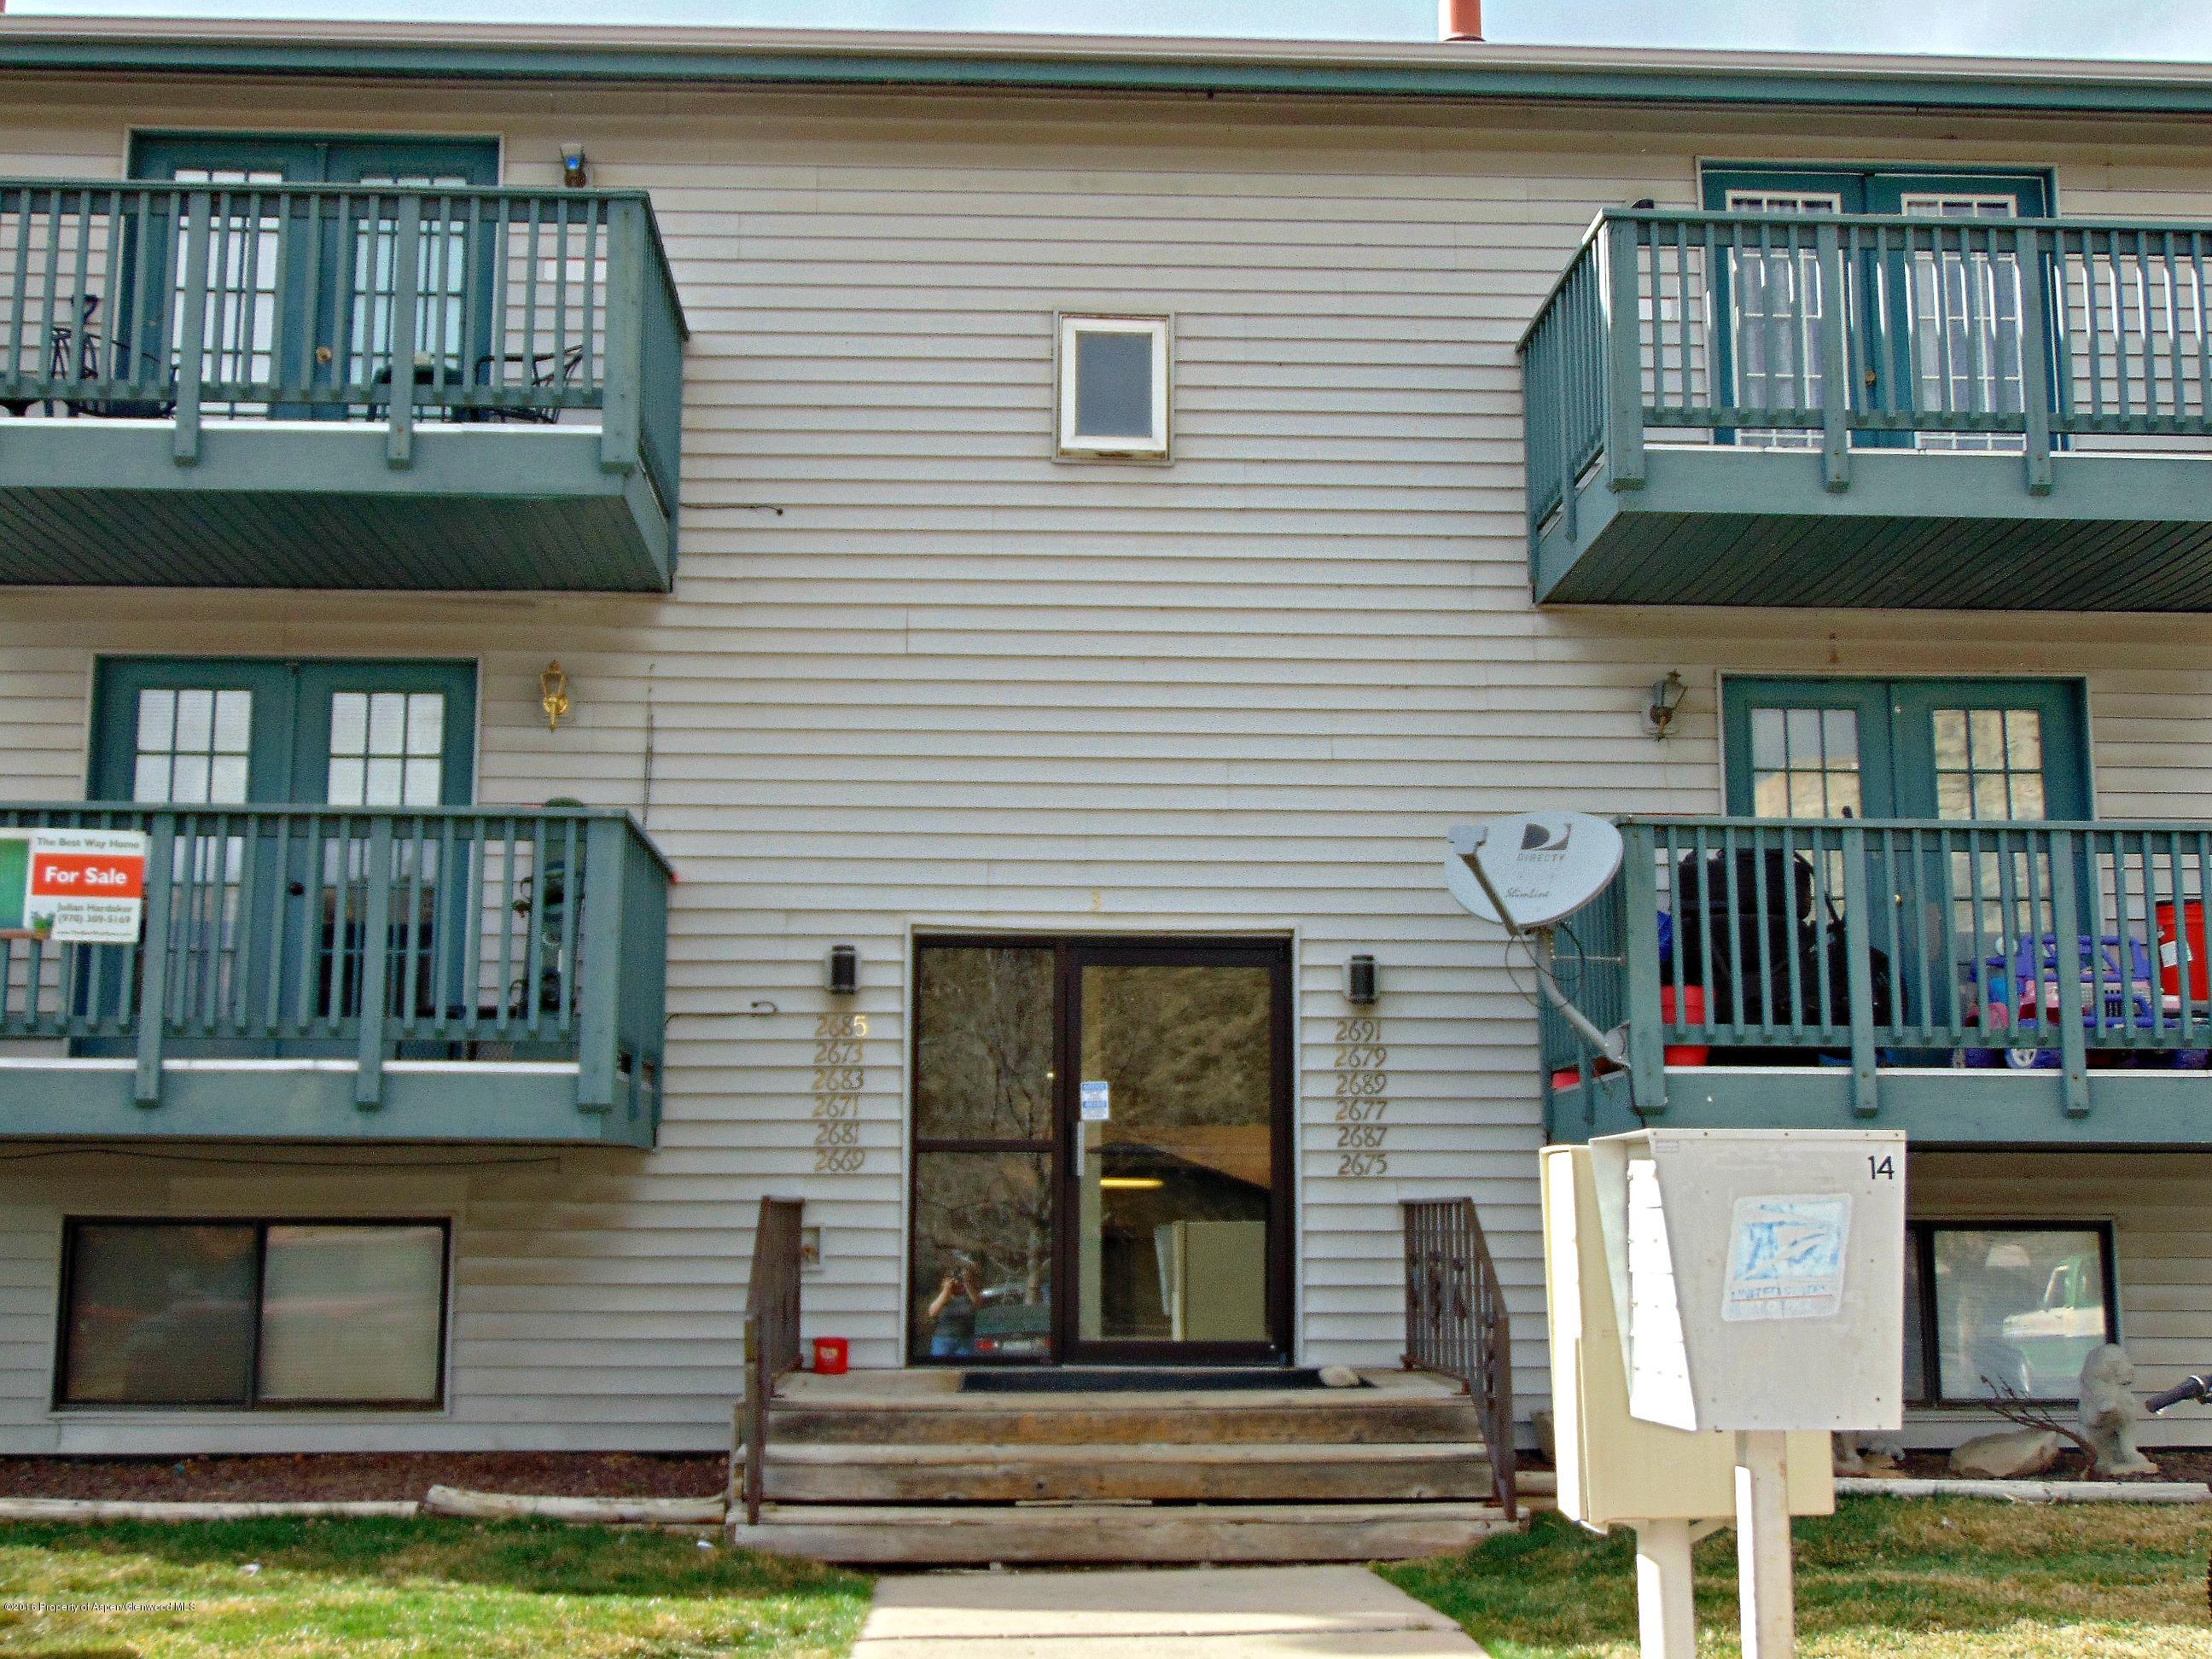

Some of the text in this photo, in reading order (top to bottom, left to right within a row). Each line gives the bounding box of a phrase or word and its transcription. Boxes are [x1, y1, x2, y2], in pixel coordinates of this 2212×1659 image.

[38, 837, 140, 849] The Best Way Home
[44, 865, 127, 884] For Sale
[1335, 1044, 1387, 1068] 2679
[1336, 1070, 1387, 1095] 2689
[1336, 1098, 1388, 1121] 2677
[1337, 1124, 1388, 1147] 2687
[1337, 1152, 1388, 1176] 2675
[1867, 1155, 1895, 1180] 14
